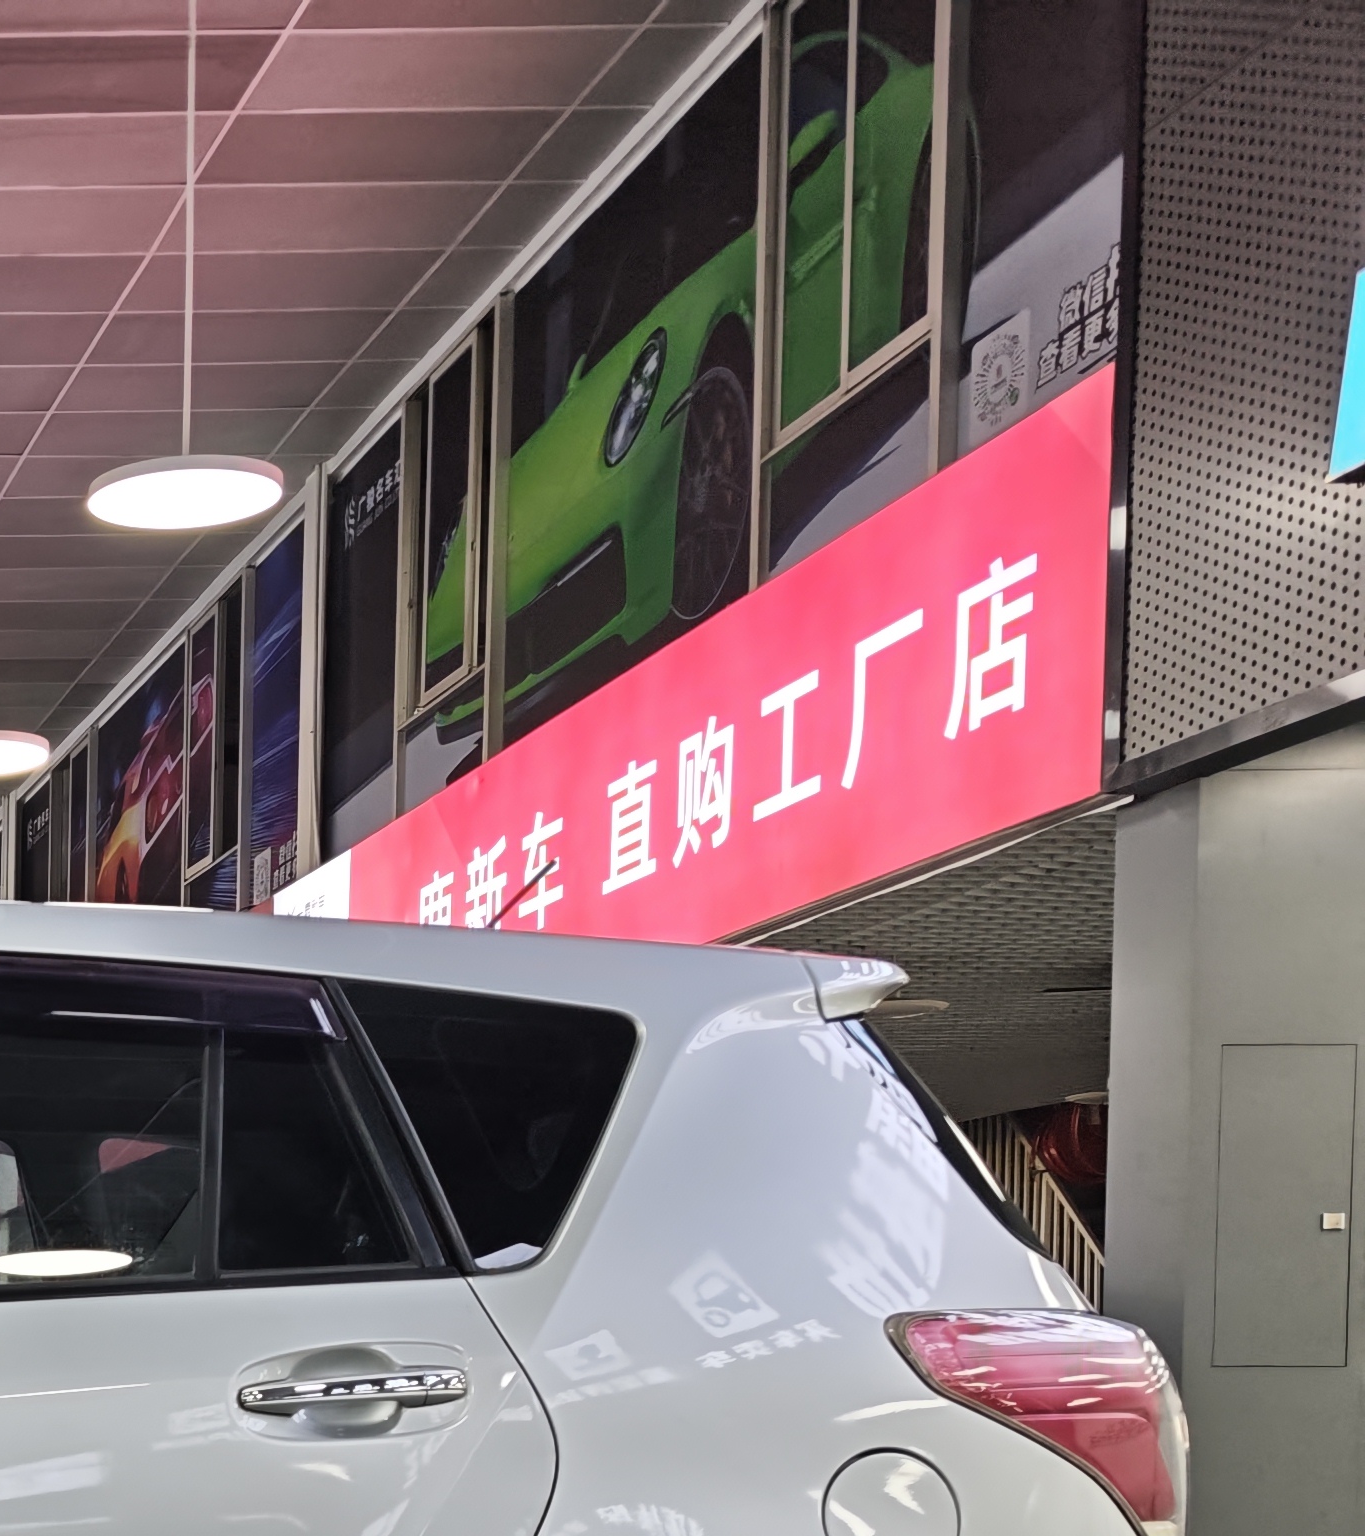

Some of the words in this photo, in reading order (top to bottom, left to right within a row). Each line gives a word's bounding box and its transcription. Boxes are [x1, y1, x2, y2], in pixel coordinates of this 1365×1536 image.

[601, 552, 1040, 896] 直购工厂店
